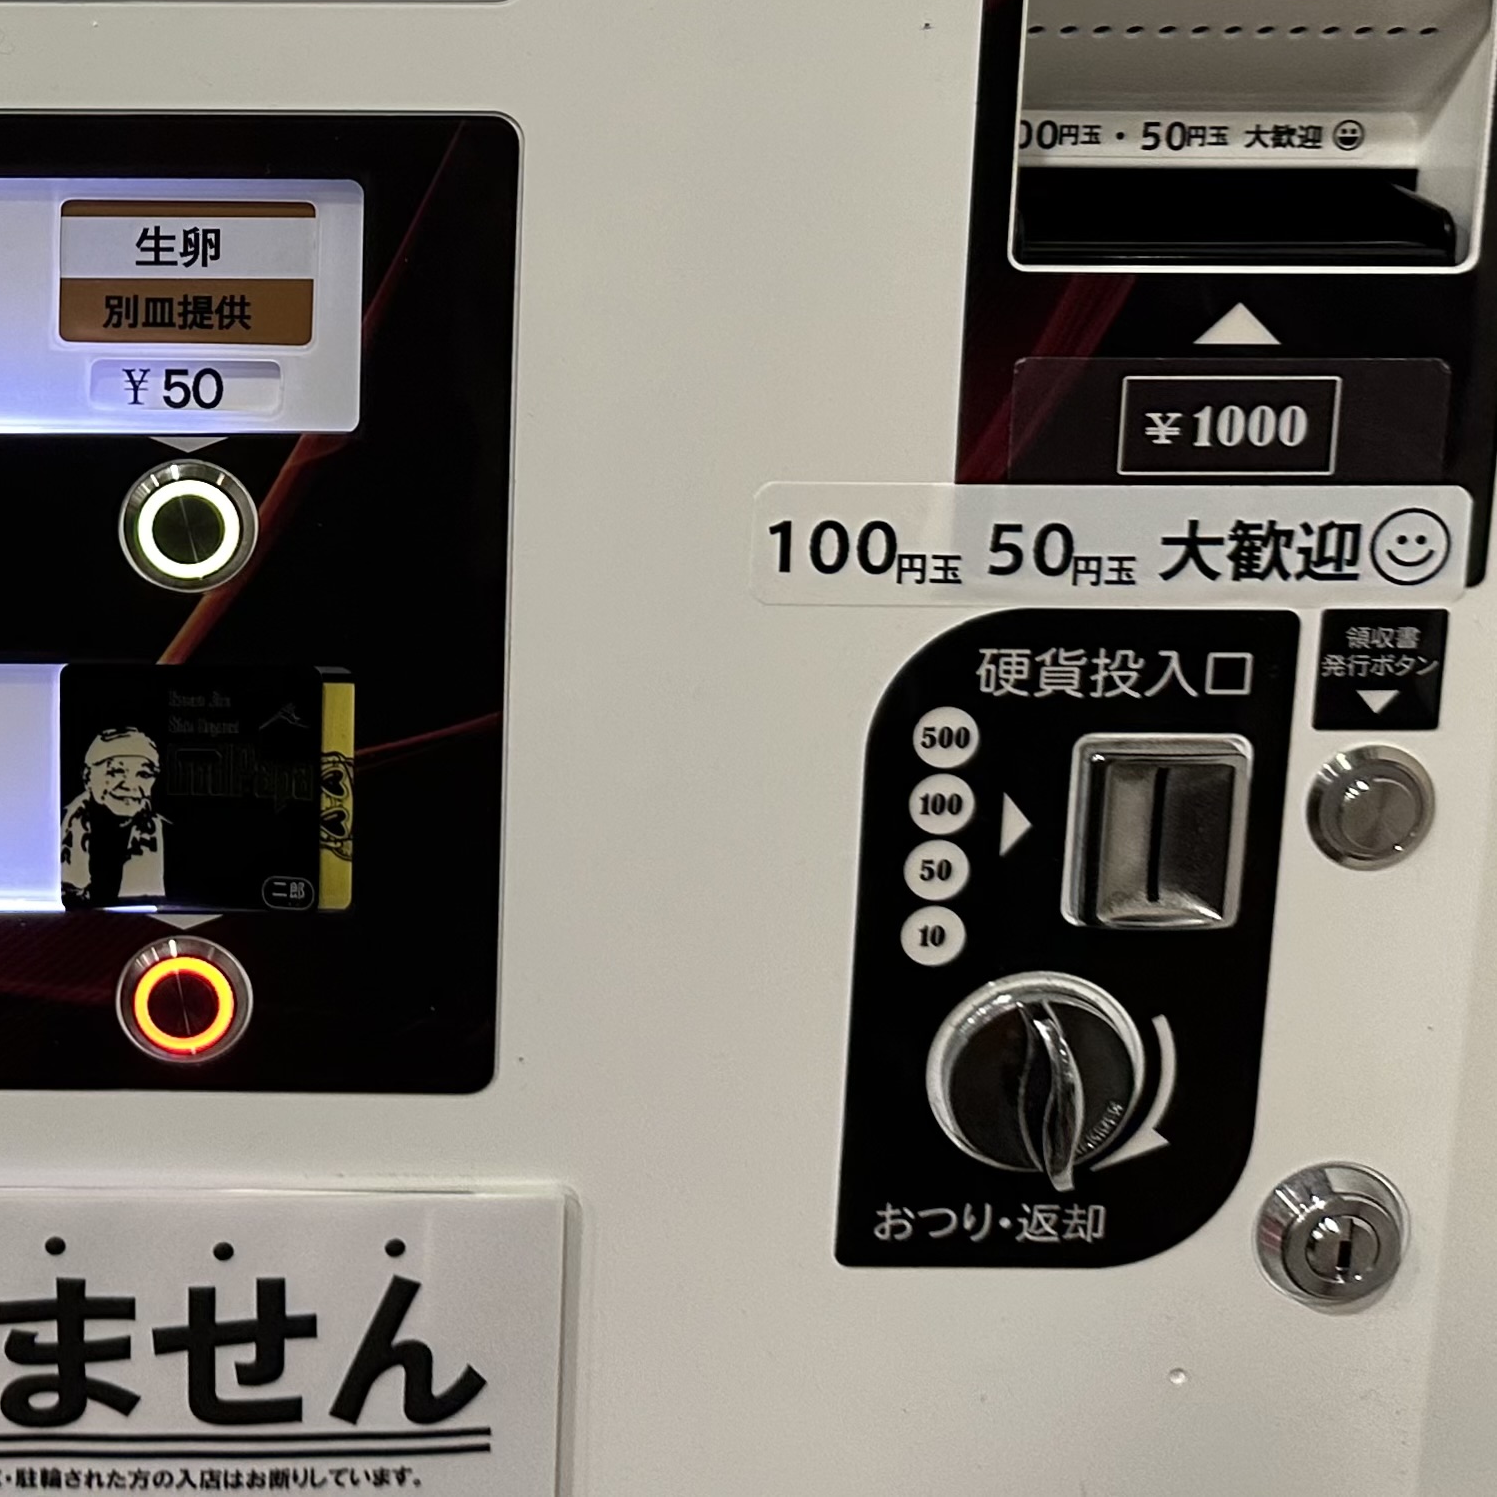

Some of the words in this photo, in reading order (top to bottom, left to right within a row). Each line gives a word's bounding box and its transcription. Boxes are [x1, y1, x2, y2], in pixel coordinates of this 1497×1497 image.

[1244, 121, 1323, 151] 大歓迎
[135, 225, 222, 269] 生卵
[103, 295, 252, 332] 別皿提供
[767, 520, 963, 586] 100円玉
[987, 521, 1138, 587] 50円玉
[1159, 518, 1364, 583] 大歓迎
[1345, 626, 1421, 649] 領収書
[975, 647, 1255, 699] 硬貨投入口
[1321, 654, 1440, 677] 発行ボタン
[919, 725, 972, 751] 500
[917, 793, 964, 816] 100
[918, 859, 953, 883] 50
[917, 924, 946, 949] 10
[874, 1202, 1107, 1244] おつり・返却
